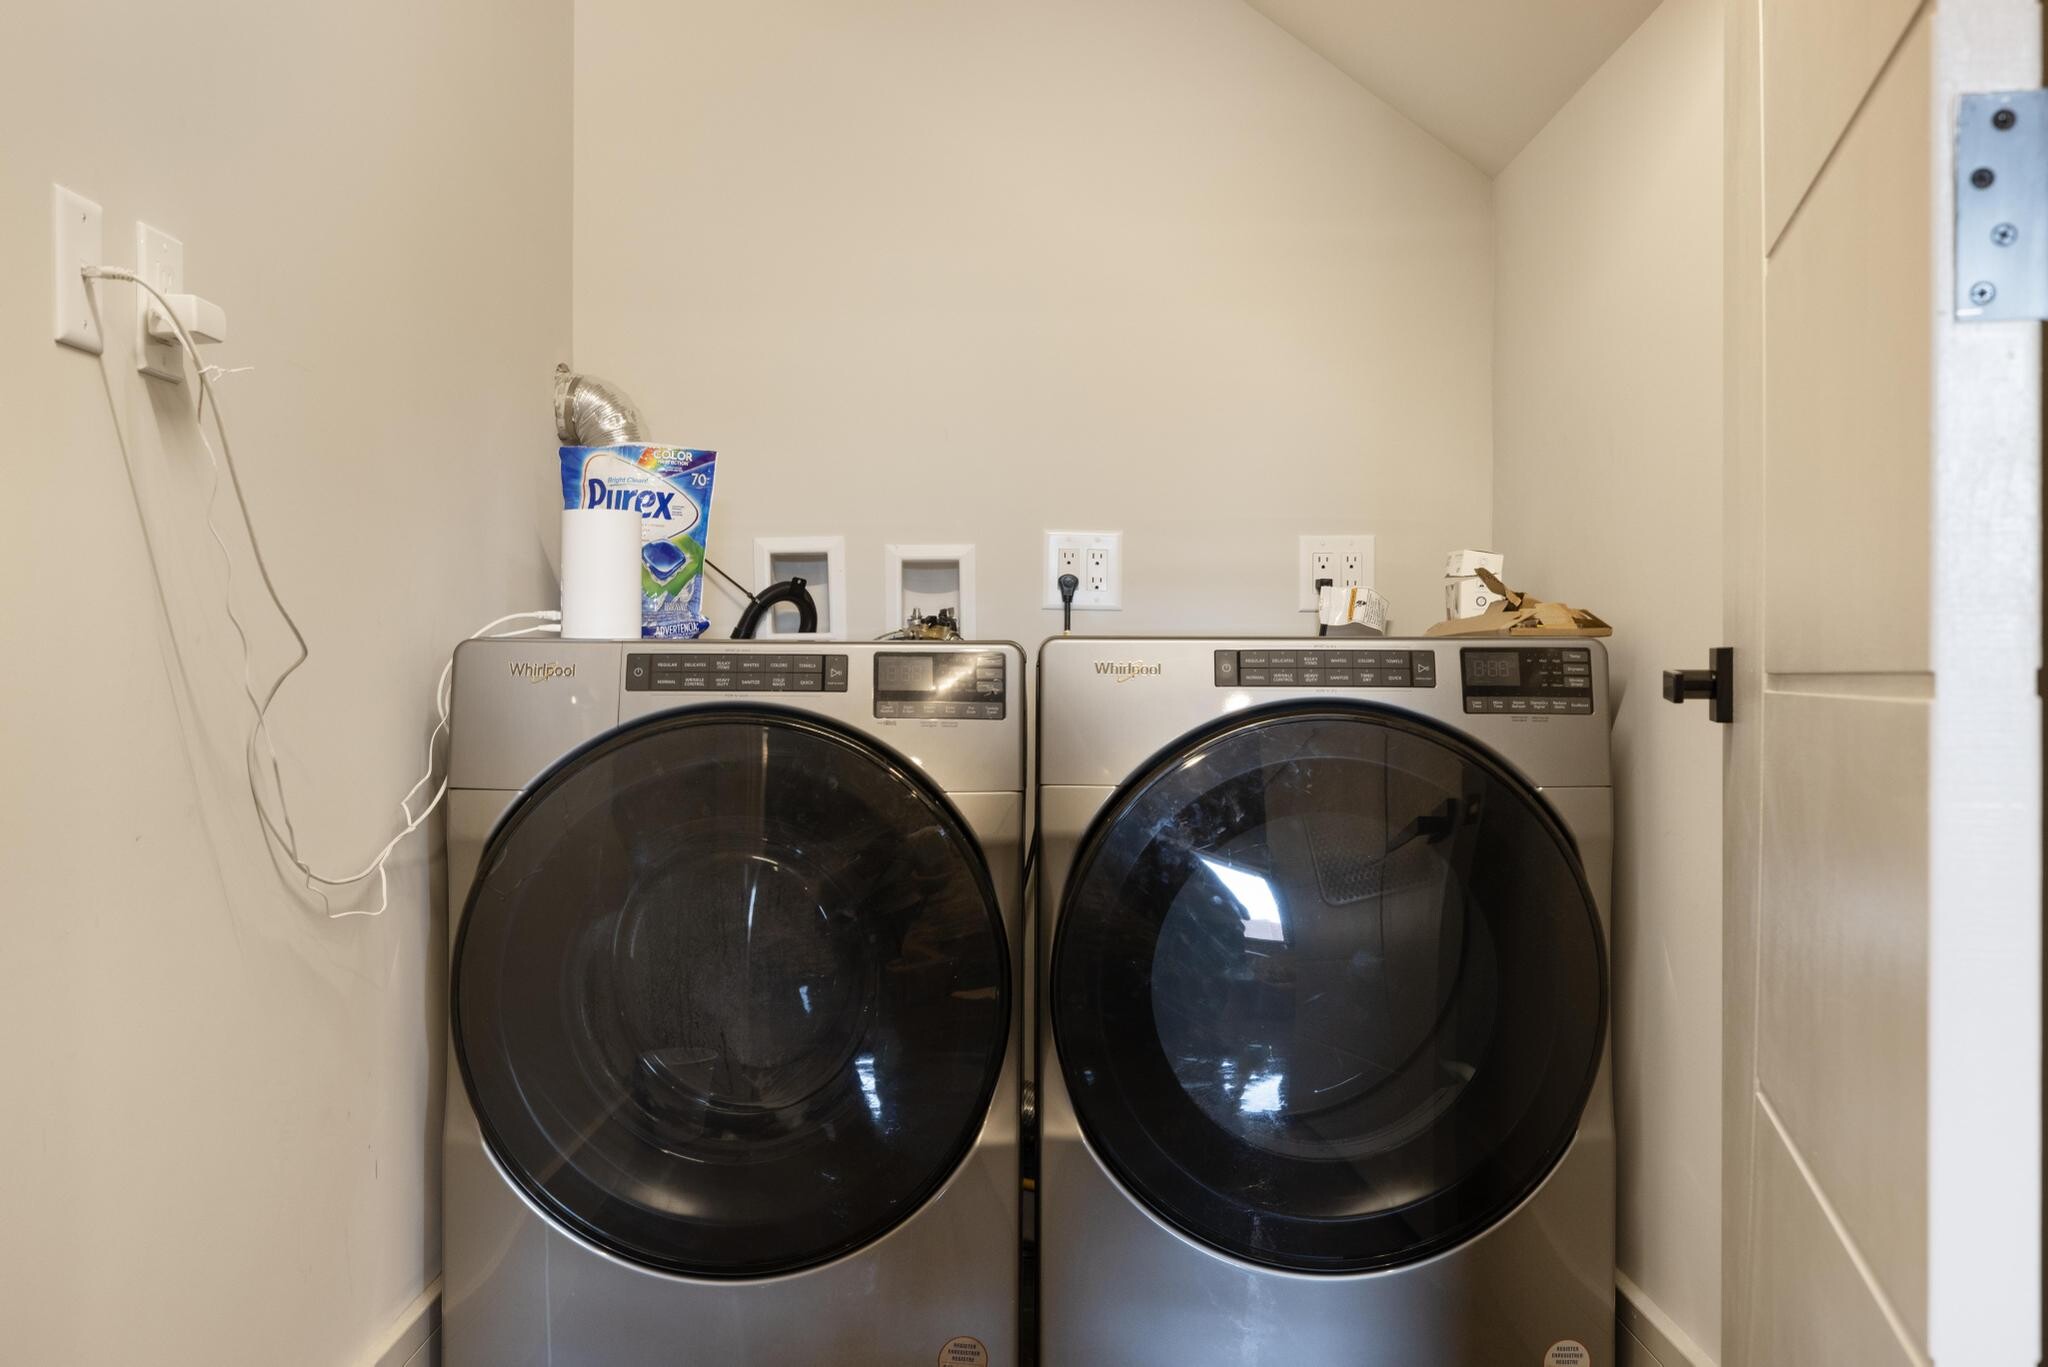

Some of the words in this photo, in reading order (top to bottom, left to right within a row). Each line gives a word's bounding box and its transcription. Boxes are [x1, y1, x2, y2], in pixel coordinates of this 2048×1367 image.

[653, 450, 693, 461] COLOR
[691, 473, 707, 486] 70
[588, 478, 675, 520] Purex
[510, 662, 576, 680] Whirlpool
[1094, 662, 1162, 678] Whirlpool
